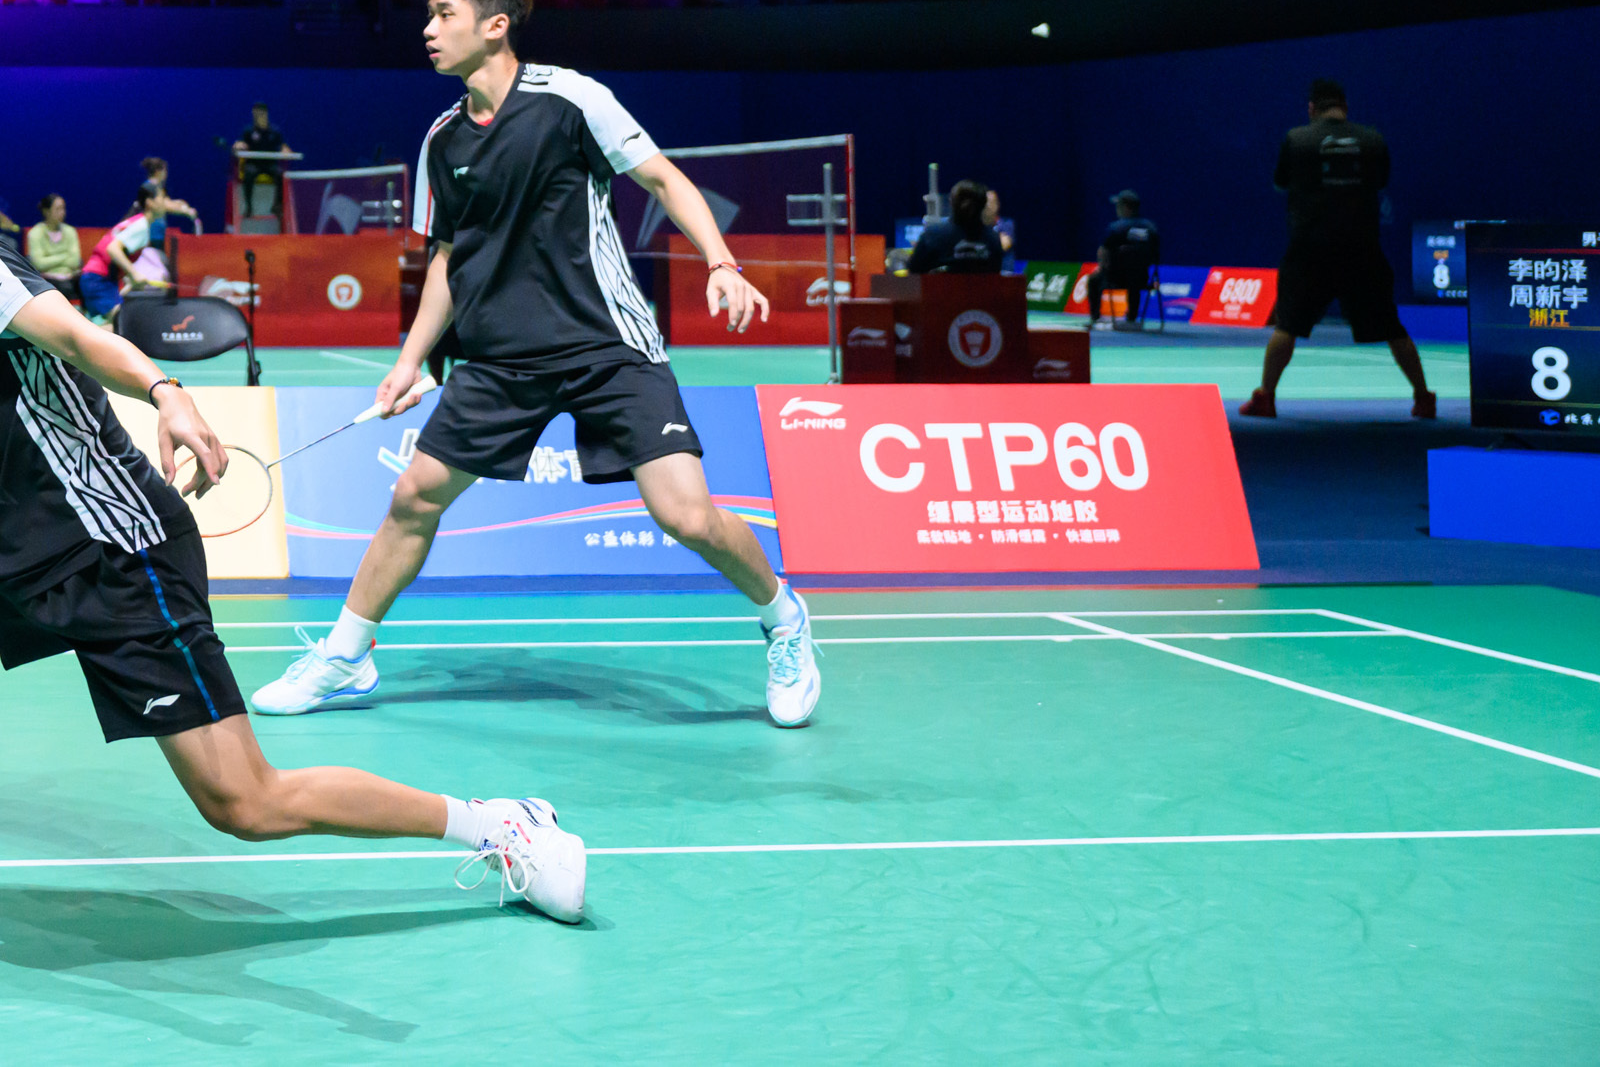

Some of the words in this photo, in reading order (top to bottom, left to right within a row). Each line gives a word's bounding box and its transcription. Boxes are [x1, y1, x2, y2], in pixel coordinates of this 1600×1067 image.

[1508, 257, 1588, 283] 李昀泽
[1509, 284, 1589, 309] 周新宇
[1529, 308, 1570, 327] 浙江
[1531, 346, 1571, 401] 8
[781, 418, 847, 430] LI-NING
[859, 422, 1149, 493] CTP60
[584, 530, 655, 548] 公益体彩
